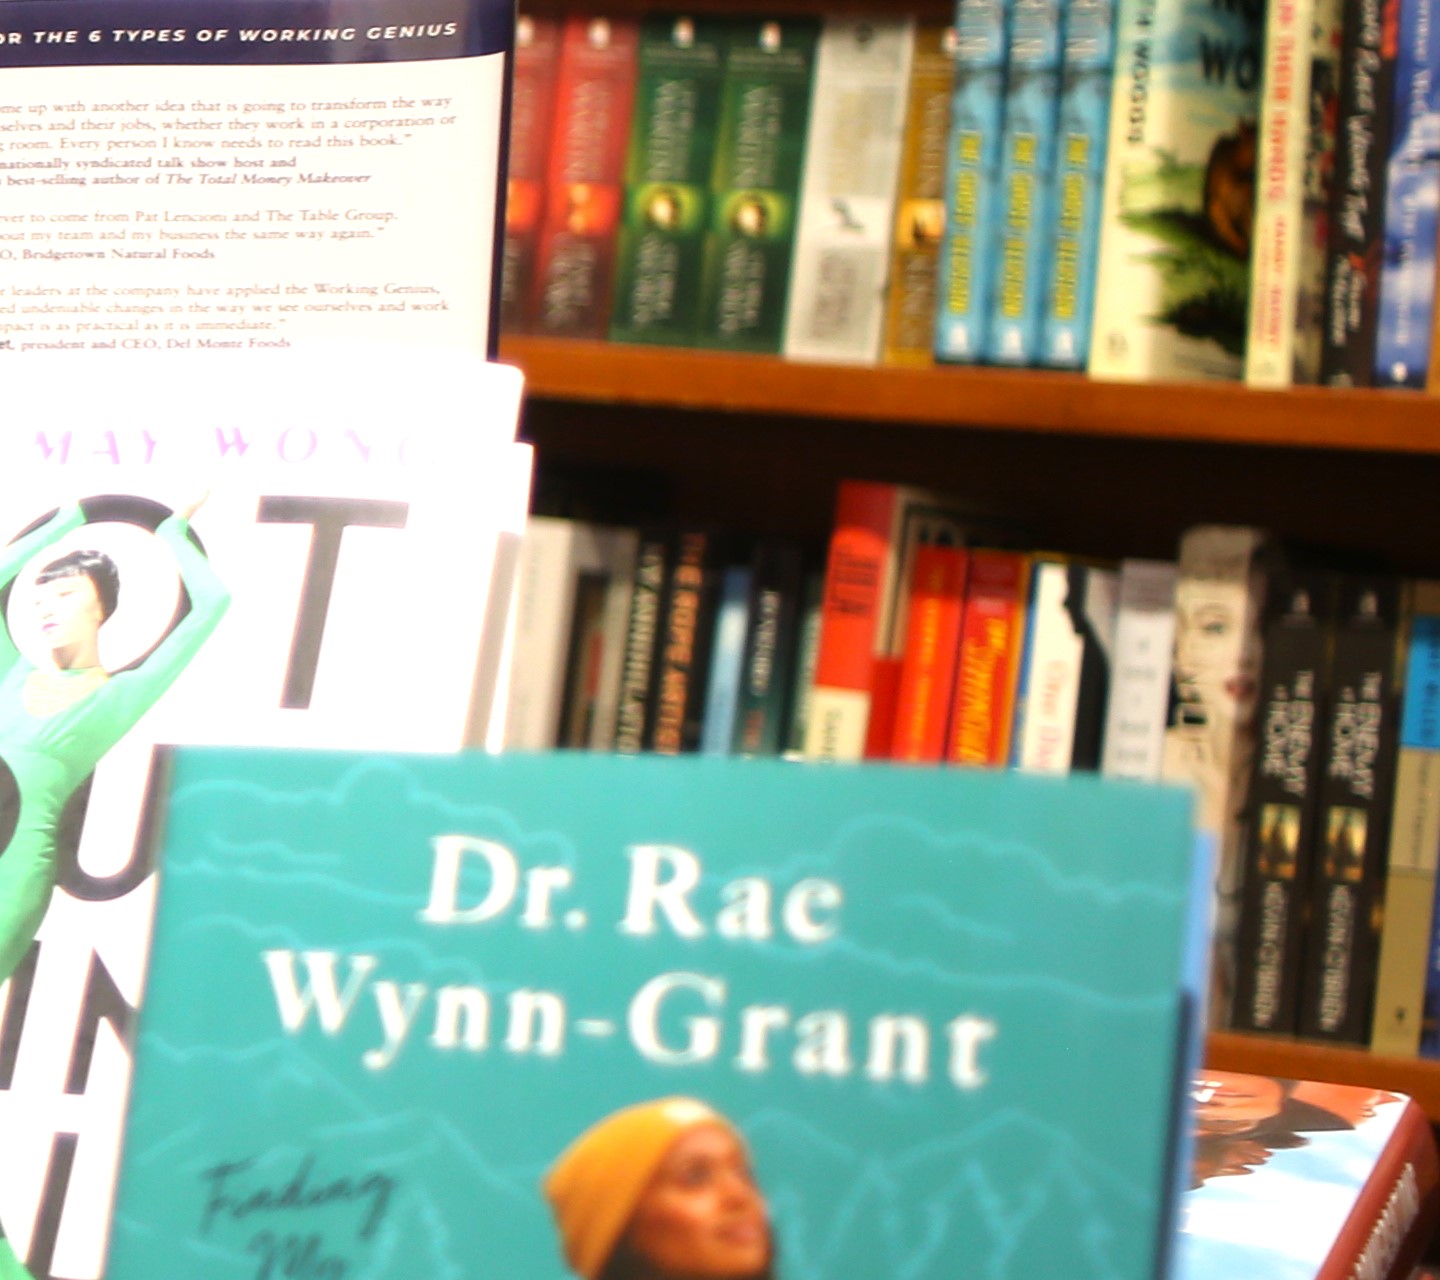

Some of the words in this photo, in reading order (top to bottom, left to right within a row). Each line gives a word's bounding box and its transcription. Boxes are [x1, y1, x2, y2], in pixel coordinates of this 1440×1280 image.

[33, 30, 79, 44] THE
[88, 30, 102, 43] 6
[112, 29, 186, 43] TYPES
[195, 29, 229, 42] OF
[238, 27, 356, 42] WORKING
[366, 22, 457, 40] GENIUS
[34, 427, 160, 467] MAY
[418, 831, 588, 934] Dr.
[258, 943, 1001, 1094] Wynn-Grant
